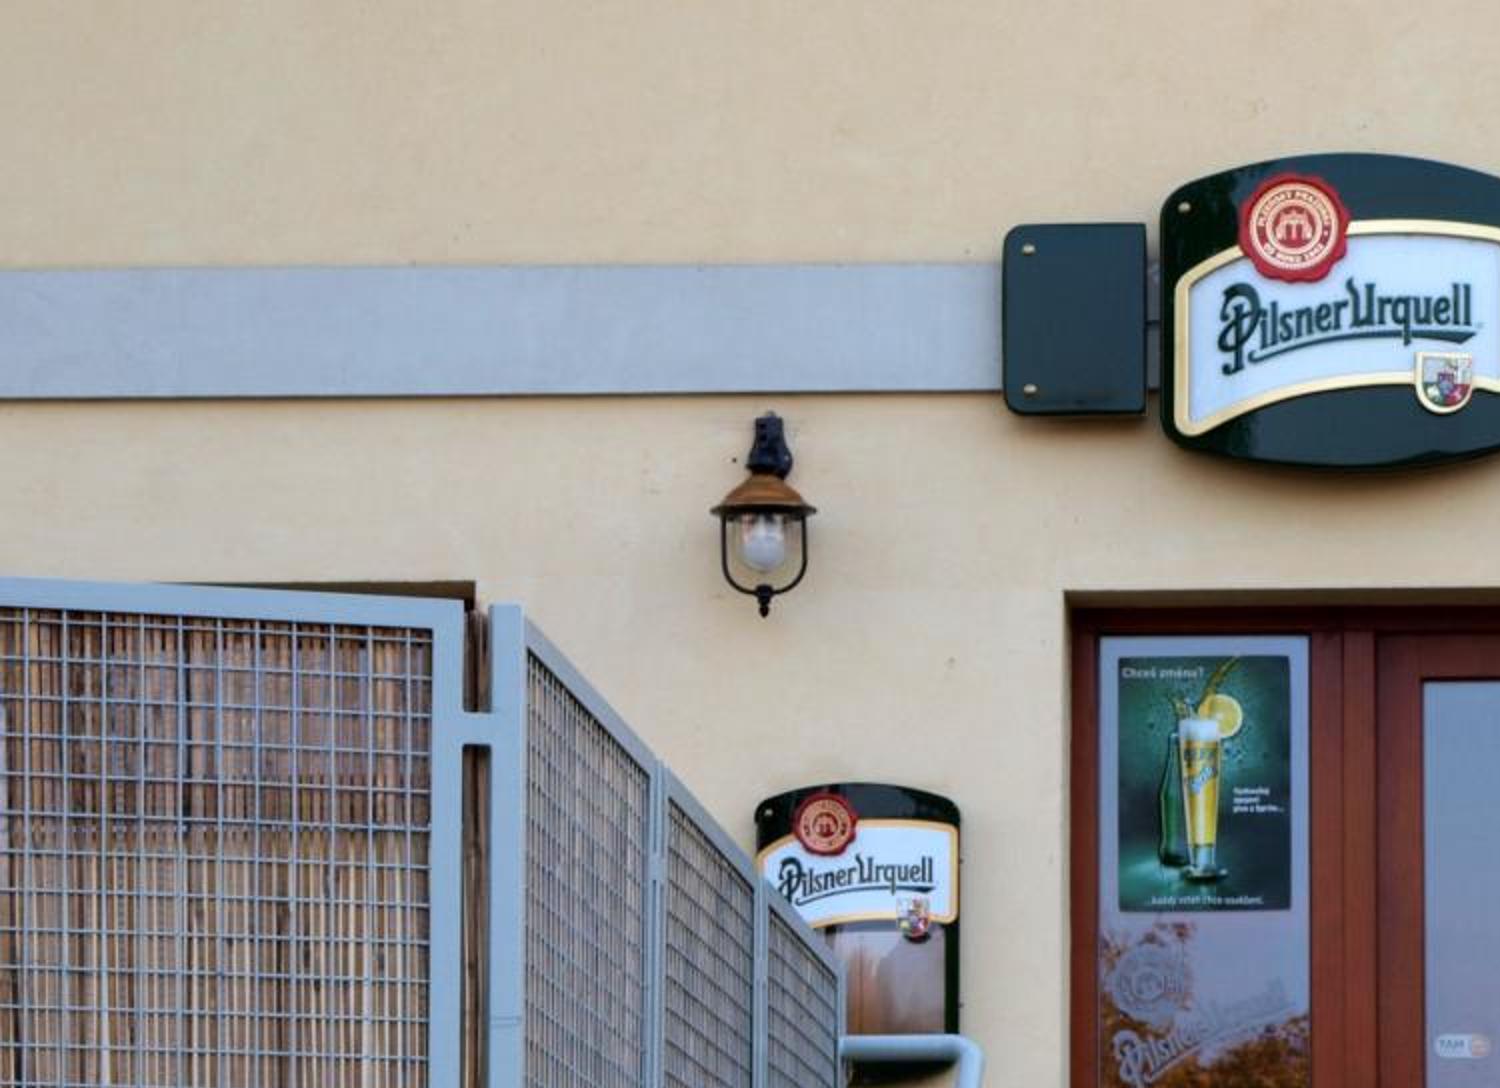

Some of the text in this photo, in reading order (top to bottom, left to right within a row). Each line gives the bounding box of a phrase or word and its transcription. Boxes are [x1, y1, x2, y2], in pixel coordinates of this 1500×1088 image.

[1217, 277, 1473, 376] Pilsner Urquell
[777, 852, 934, 905] Pilsner Urquell
